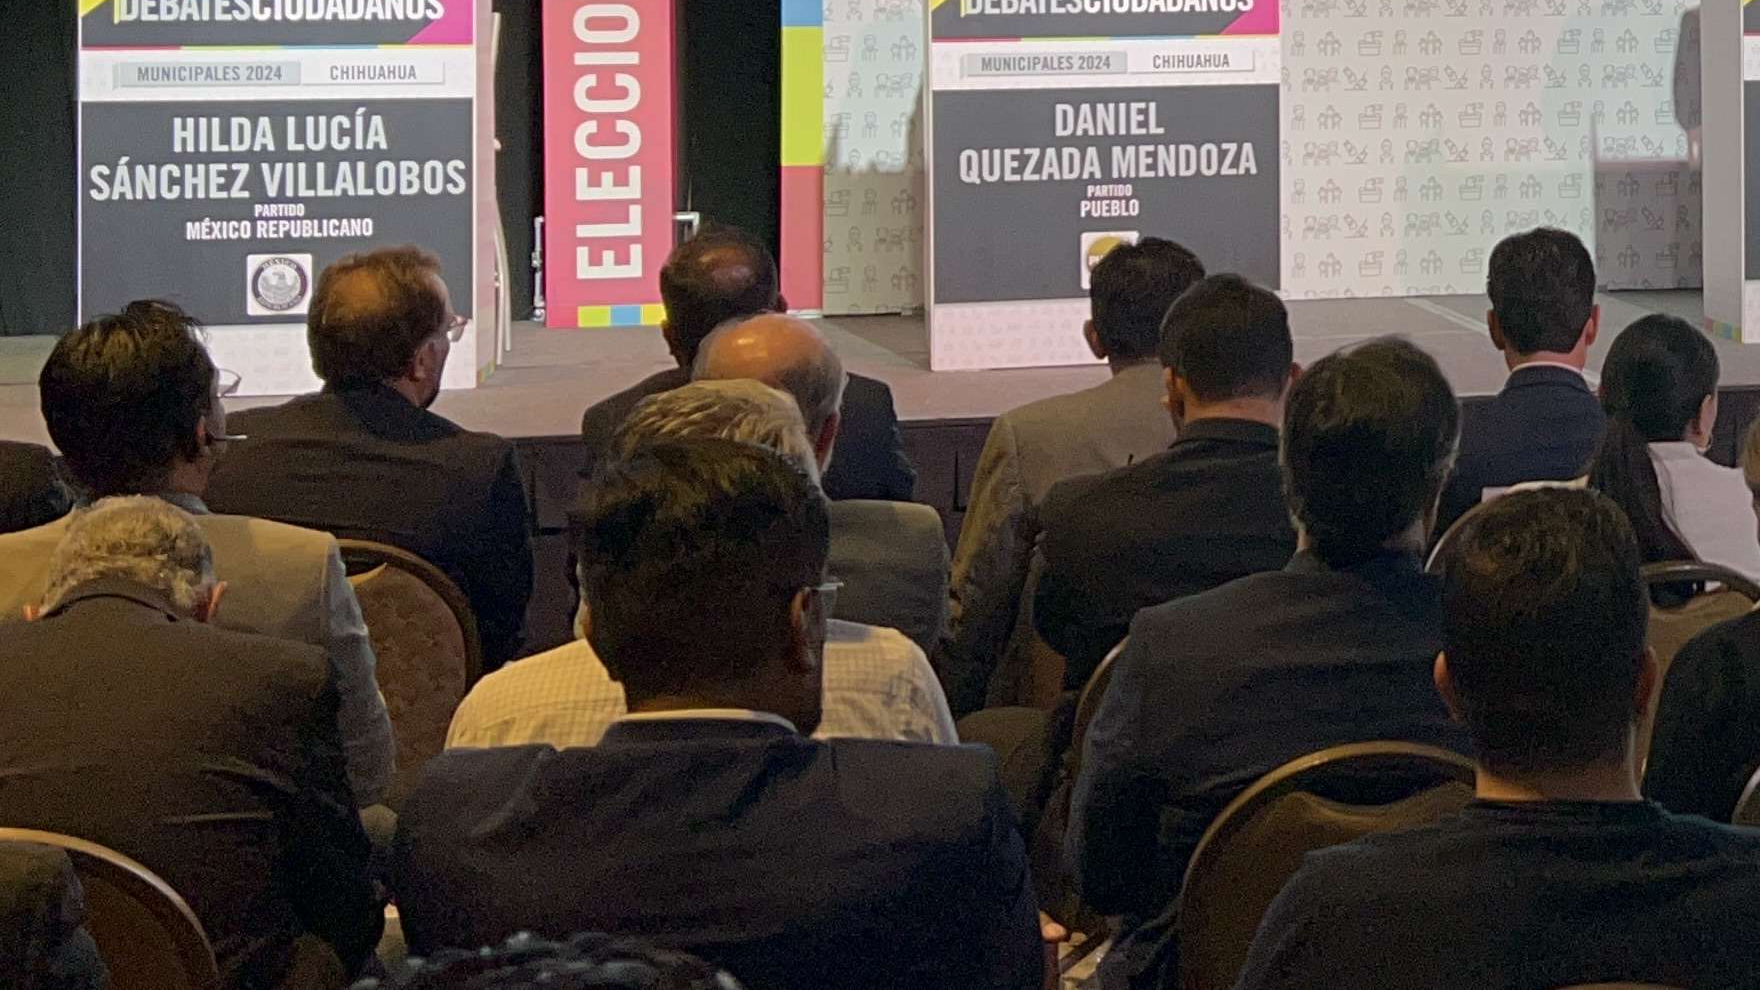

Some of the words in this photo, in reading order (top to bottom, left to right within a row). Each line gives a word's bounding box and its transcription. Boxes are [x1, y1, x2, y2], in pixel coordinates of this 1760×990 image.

[981, 56, 1074, 72] MUNICIPALES
[1078, 55, 1111, 70] 2024
[1153, 53, 1230, 69] CHIHUAHUA
[137, 65, 241, 82] MUNICIPALES
[246, 65, 283, 81] 2024
[330, 65, 417, 81] CHIHUAHUA
[1055, 102, 1165, 137] DANIEL
[173, 116, 275, 153] HILDA
[287, 107, 388, 152] LUCÍA
[959, 147, 1102, 184] QUEZADA
[1112, 142, 1257, 179] MENDOZA
[90, 156, 250, 200] SÁNCHEZ
[261, 159, 467, 198] VILLALOBOS
[1087, 184, 1133, 197] PARTIDO
[254, 203, 305, 218] PARTIDO
[1080, 199, 1139, 217] PUEBLO
[186, 217, 252, 241] MÉXICO
[256, 218, 373, 239] REPUBLICANO
